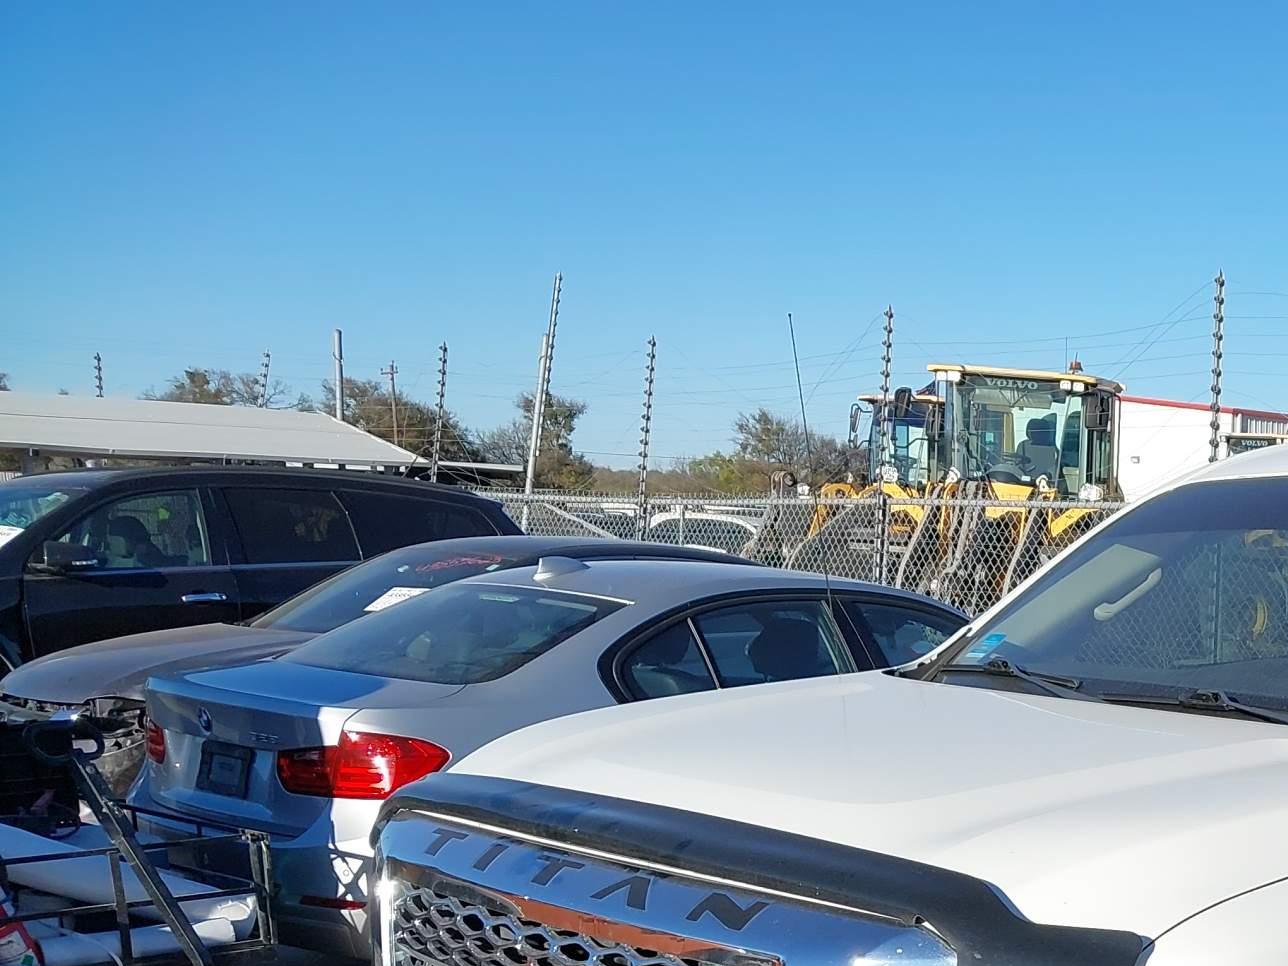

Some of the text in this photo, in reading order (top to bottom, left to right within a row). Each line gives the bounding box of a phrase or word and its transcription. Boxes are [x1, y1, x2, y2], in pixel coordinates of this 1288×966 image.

[985, 377, 1038, 390] VOLVO
[1241, 439, 1269, 447] VOLVO
[425, 827, 771, 932] TITAN
